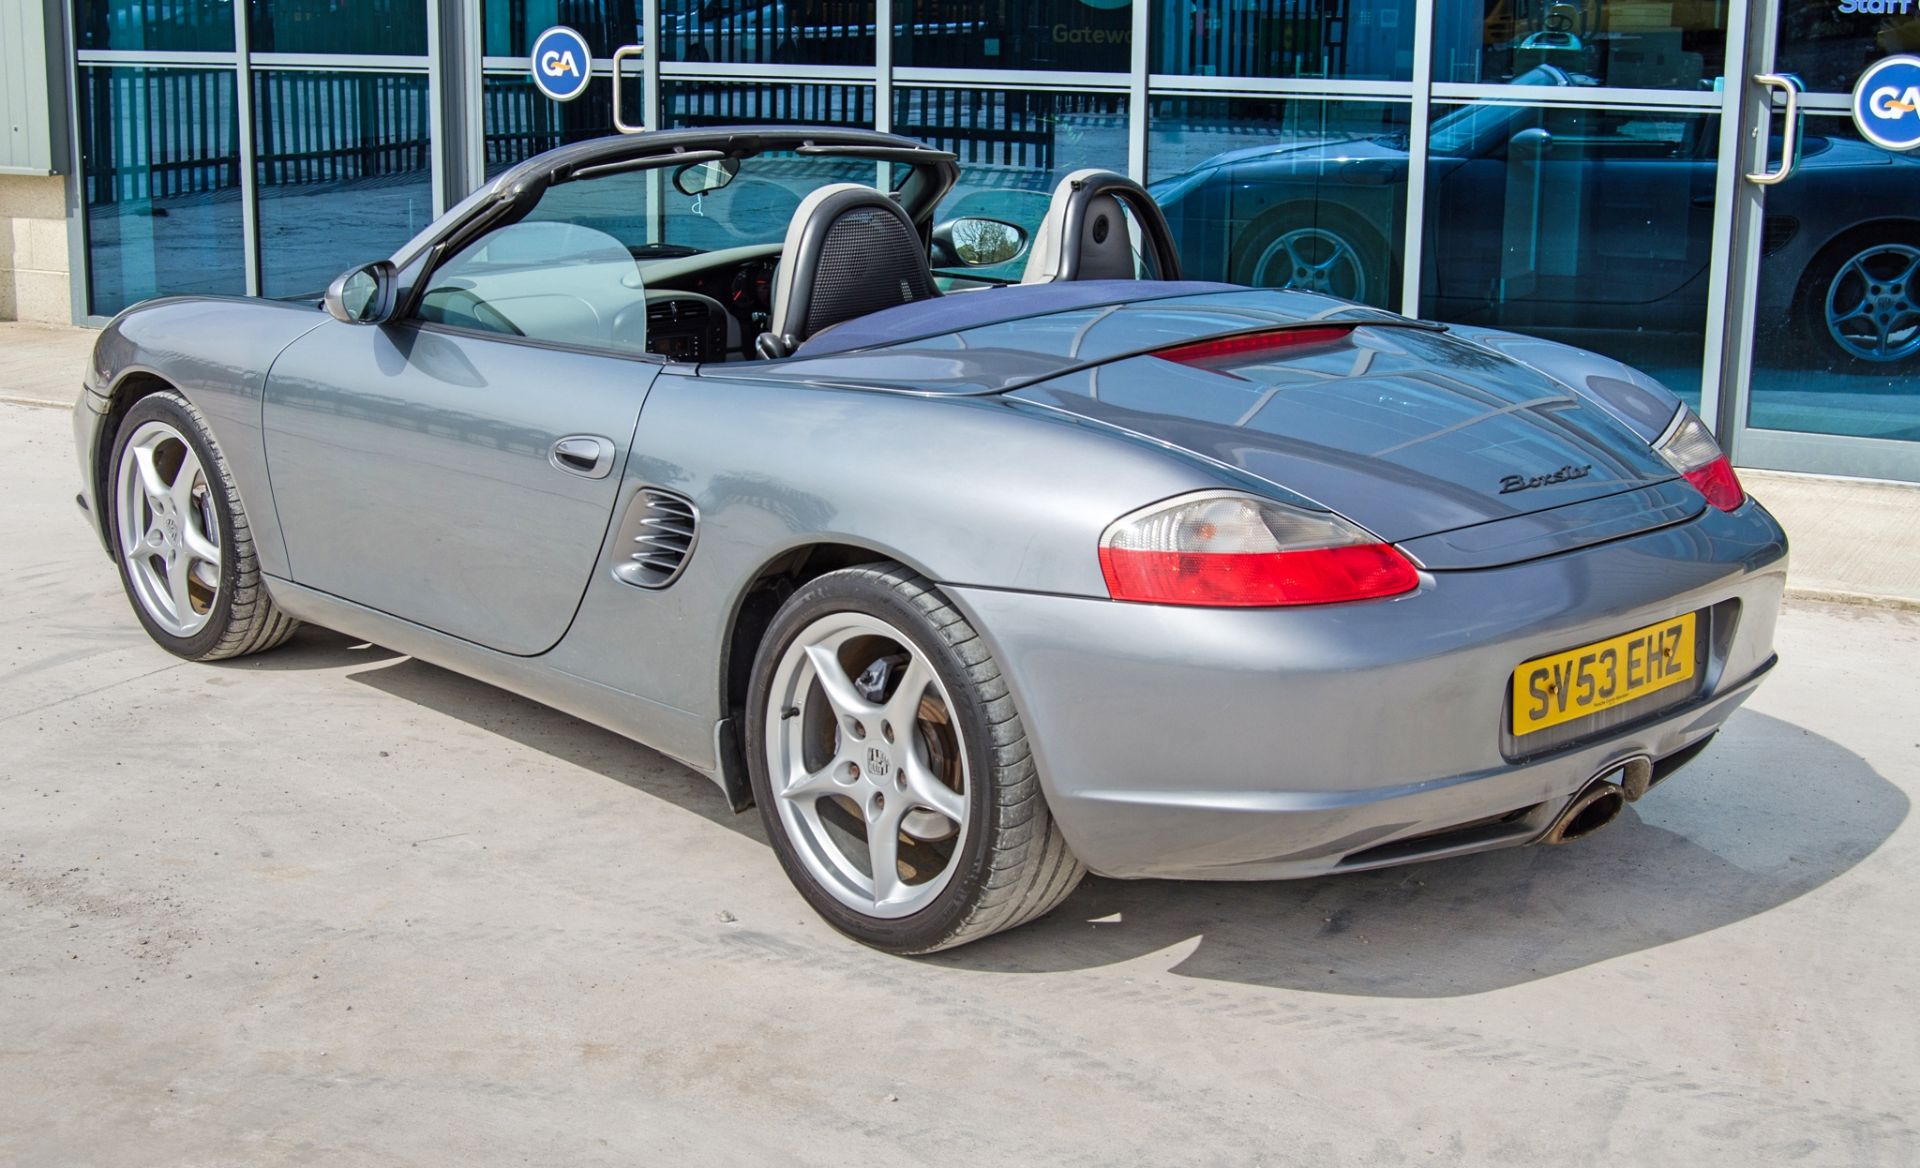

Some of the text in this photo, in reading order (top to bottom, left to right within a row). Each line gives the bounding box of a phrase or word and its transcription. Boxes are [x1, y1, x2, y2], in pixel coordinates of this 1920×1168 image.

[1838, 0, 1911, 14] Staff
[541, 50, 580, 77] GA
[1499, 465, 1592, 494] Boxster
[1528, 624, 1683, 721] SV53 EHZ
